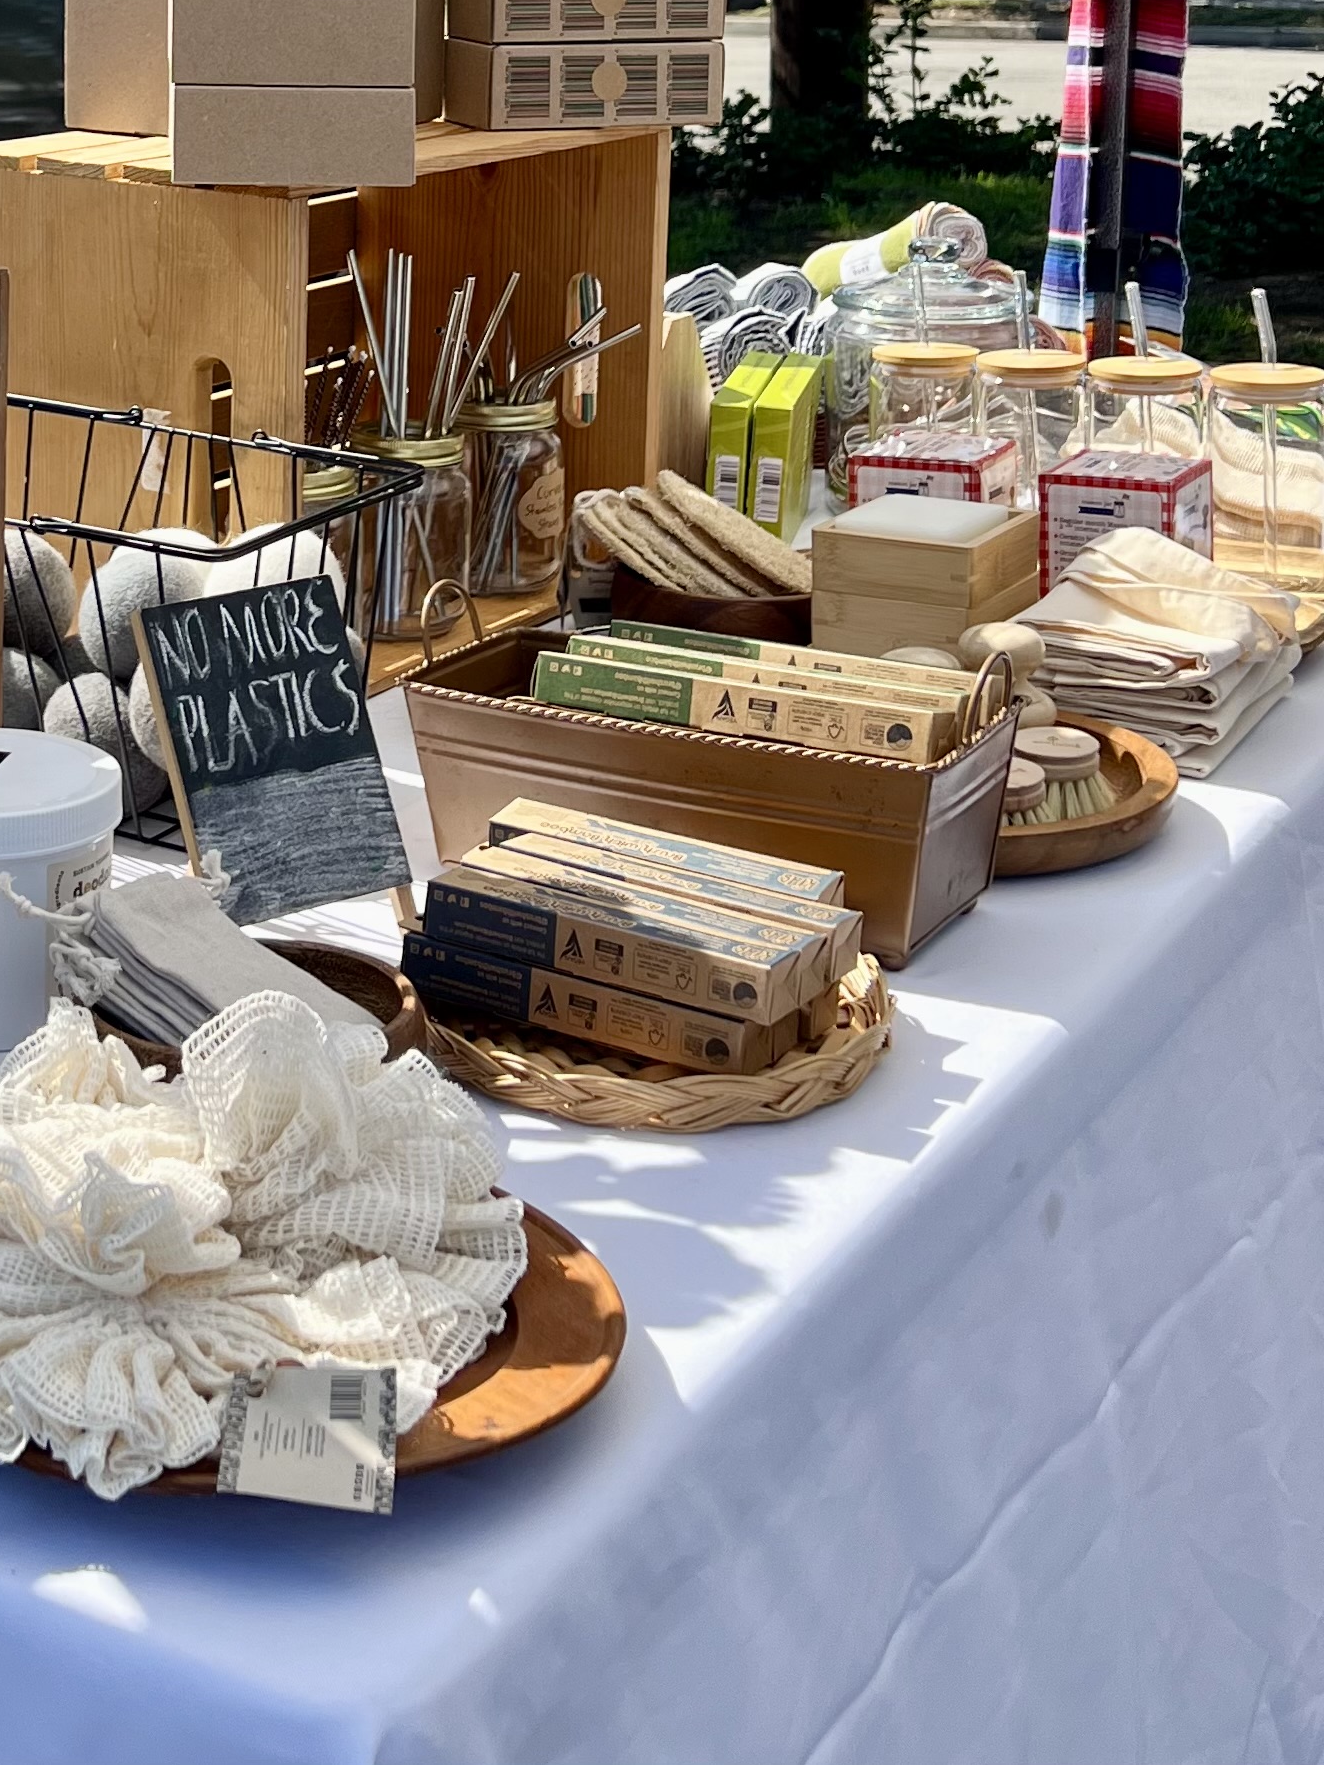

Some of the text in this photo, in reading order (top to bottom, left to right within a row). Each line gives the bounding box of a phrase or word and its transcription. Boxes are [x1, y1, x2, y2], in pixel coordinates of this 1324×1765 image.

[149, 579, 339, 689] NO MORE
[177, 658, 360, 774] PLASTICS
[537, 819, 685, 863] Brush with Bamboo
